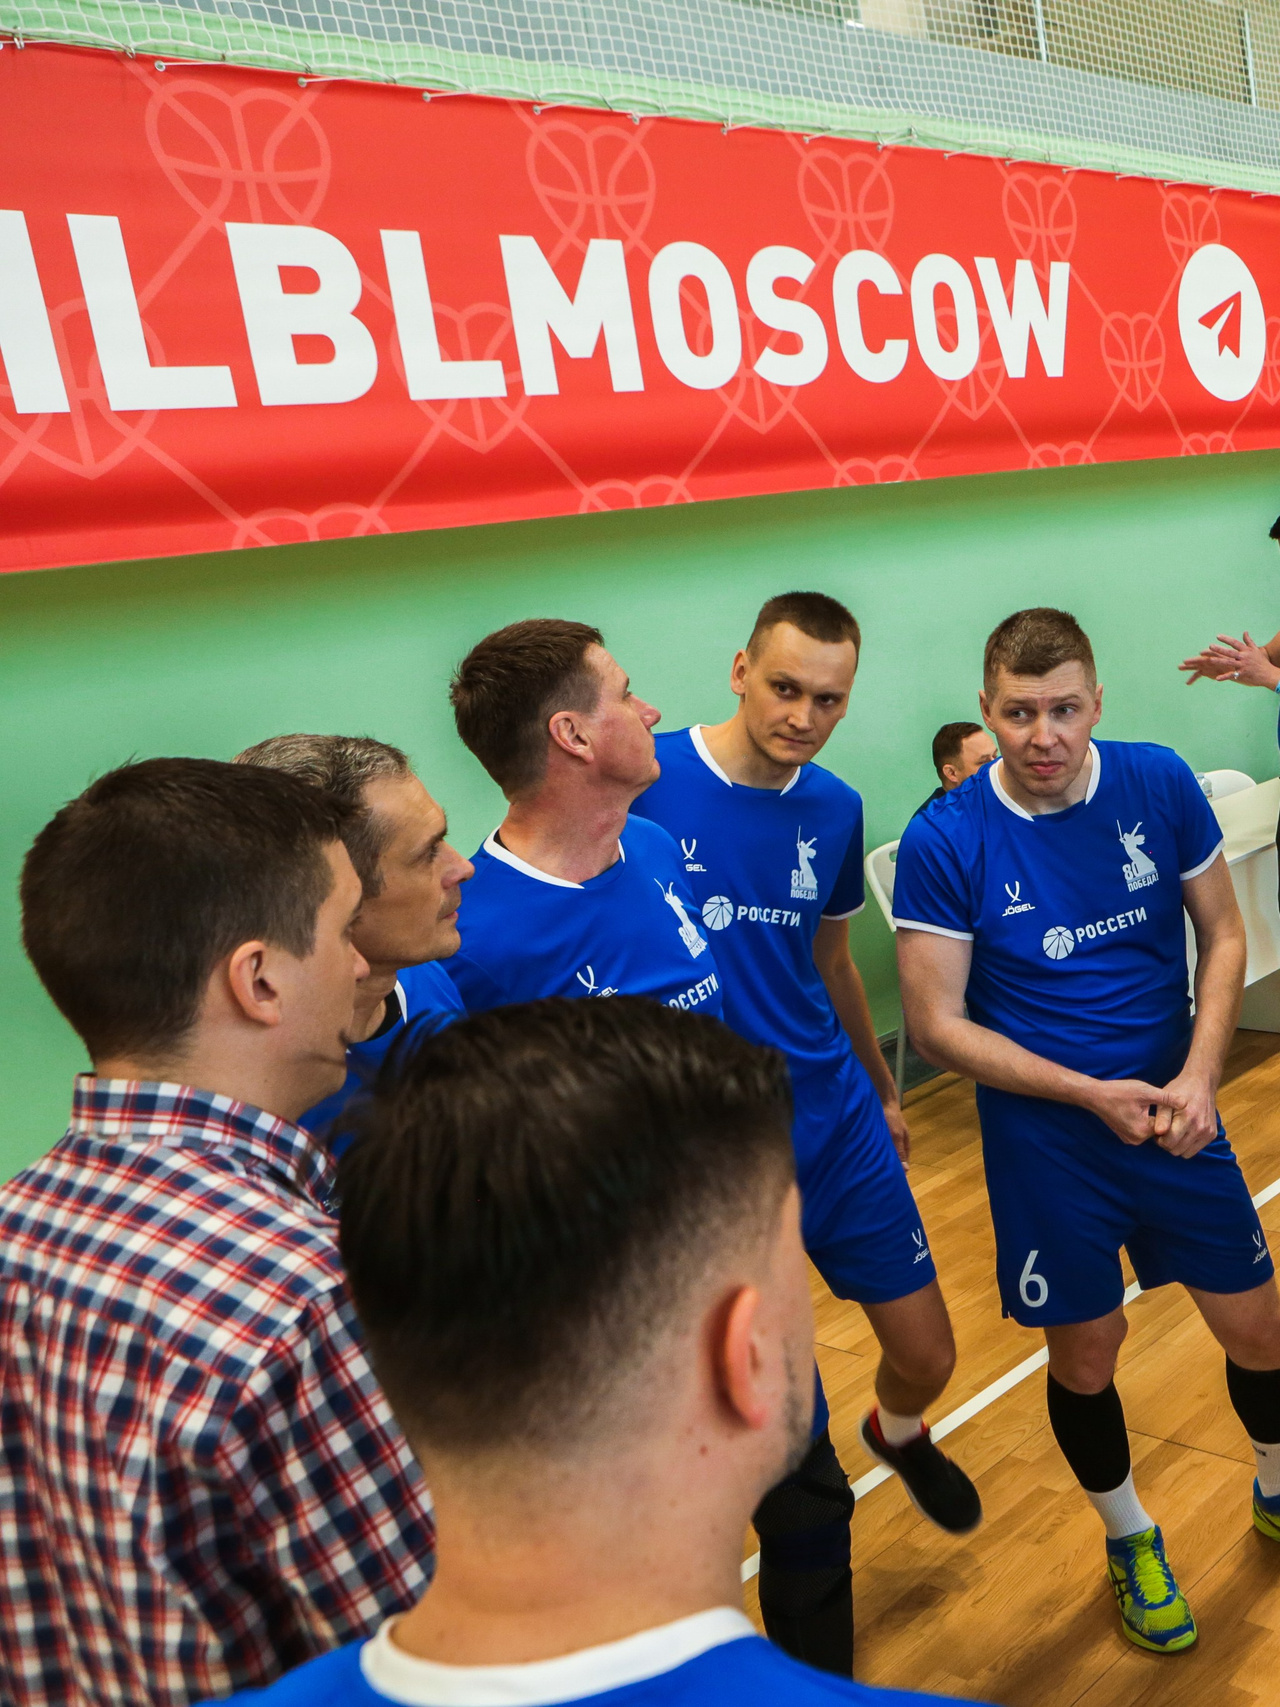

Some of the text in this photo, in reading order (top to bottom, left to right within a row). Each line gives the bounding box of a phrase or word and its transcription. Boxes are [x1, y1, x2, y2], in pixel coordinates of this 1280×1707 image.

[685, 864, 707, 872] GEL
[1127, 873, 1160, 893] ПОБЕДА!
[1002, 903, 1036, 917] JÖGEL
[1075, 906, 1148, 943] РОССЕТИ
[663, 972, 719, 1011] ОССЕТИ
[1018, 1248, 1049, 1308] 6
